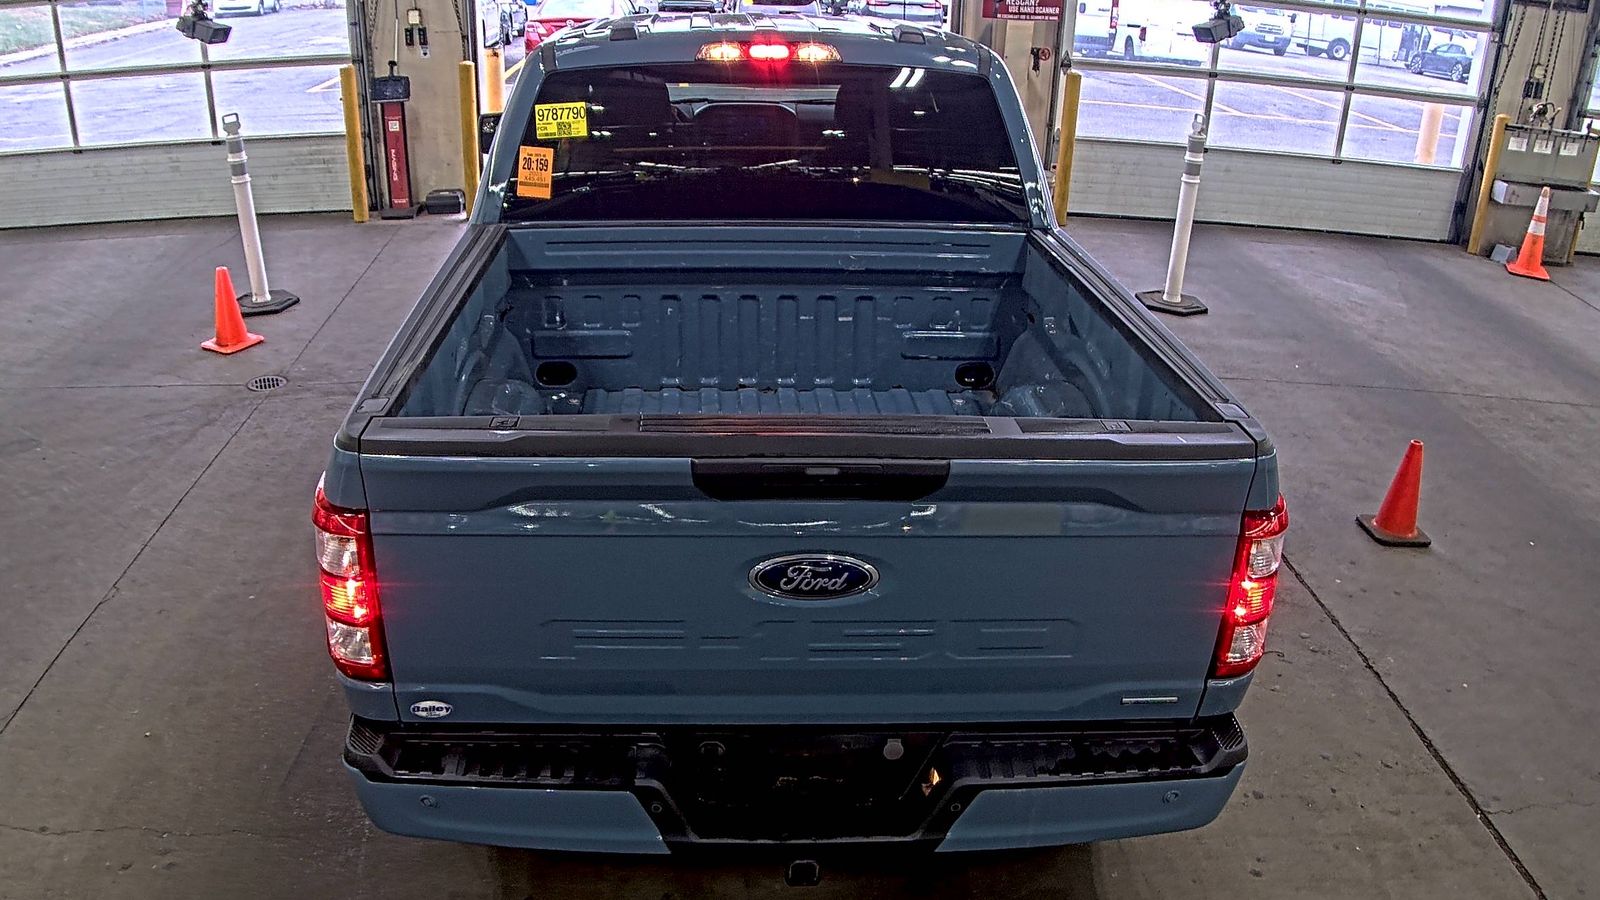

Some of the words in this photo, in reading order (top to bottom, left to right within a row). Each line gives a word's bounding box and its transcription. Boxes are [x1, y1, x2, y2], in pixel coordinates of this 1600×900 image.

[537, 106, 586, 121] 9787790
[522, 157, 549, 171] 20:159
[780, 565, 849, 590] Ford
